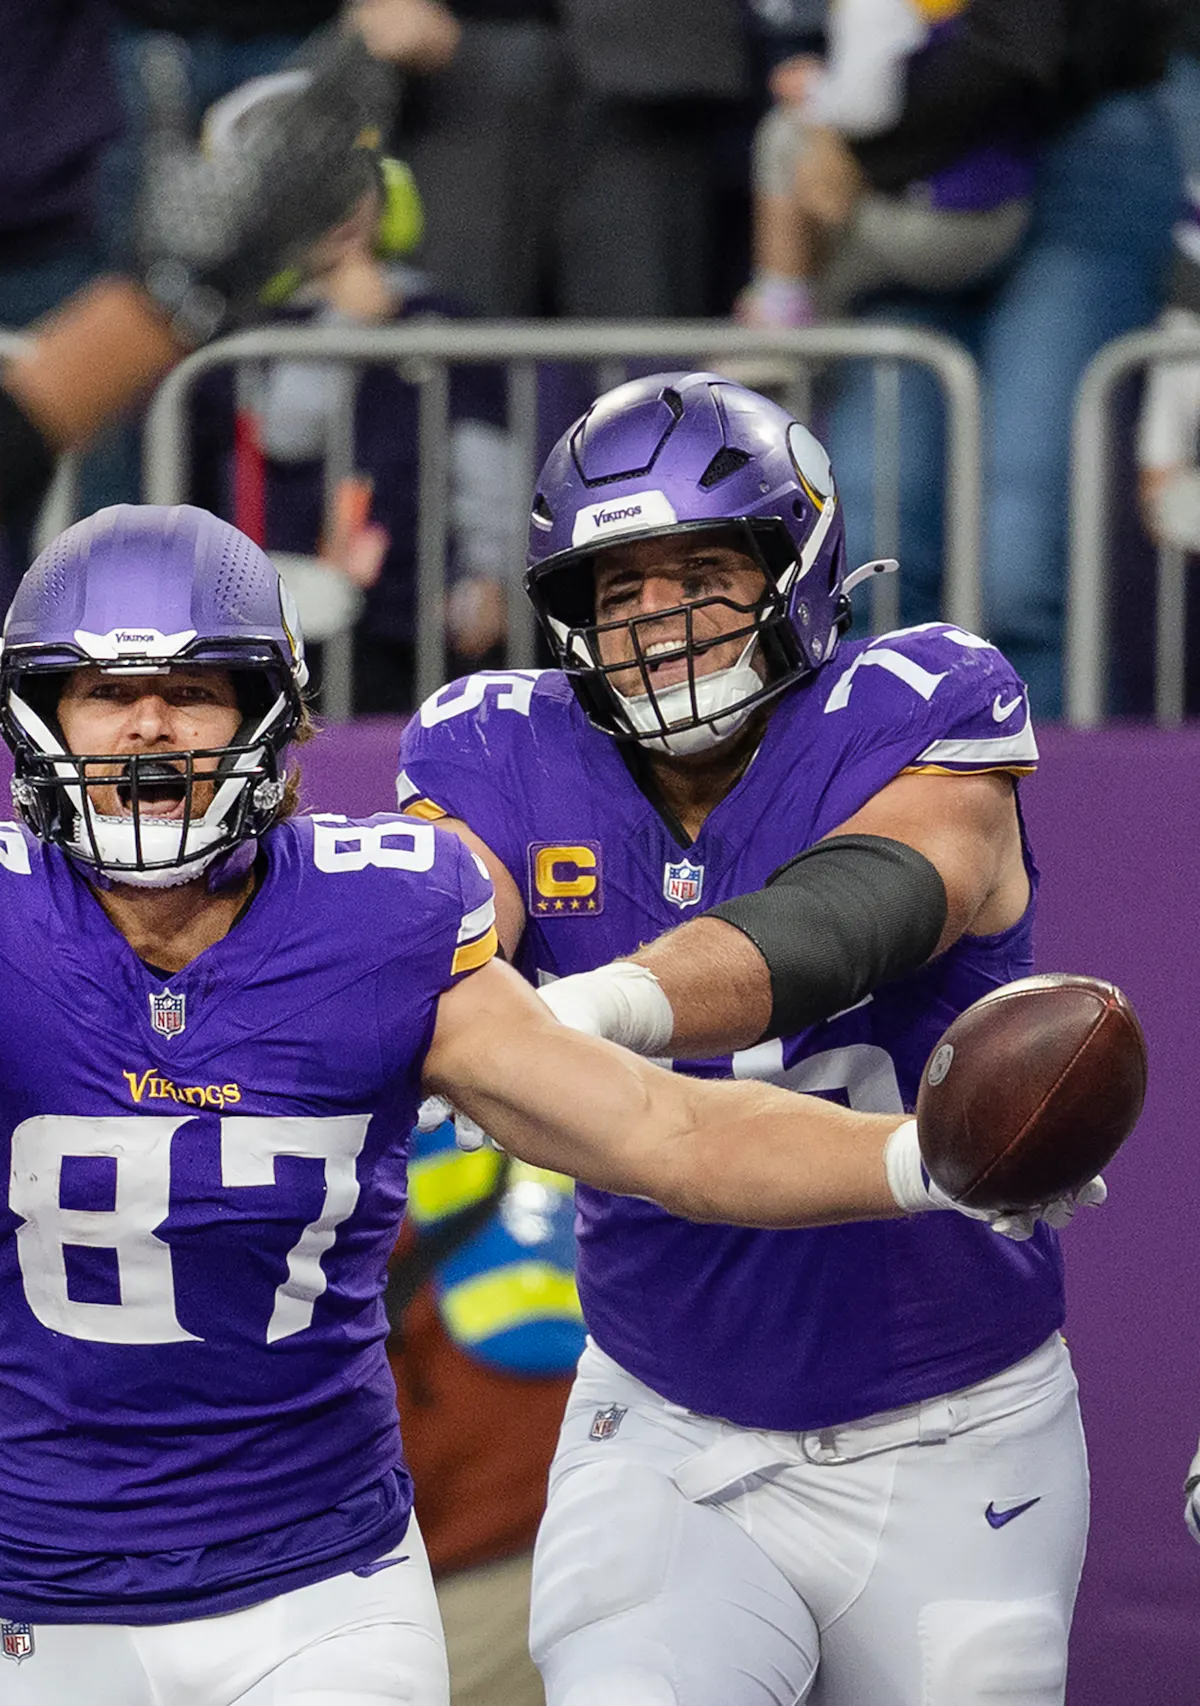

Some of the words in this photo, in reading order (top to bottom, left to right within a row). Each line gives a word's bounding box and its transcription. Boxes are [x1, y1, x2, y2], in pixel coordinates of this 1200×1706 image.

[535, 846, 596, 898] C
[670, 880, 697, 899] NFL
[157, 1011, 181, 1029] NFL
[8, 1114, 373, 1344] 87
[6, 1636, 30, 1654] NFL
